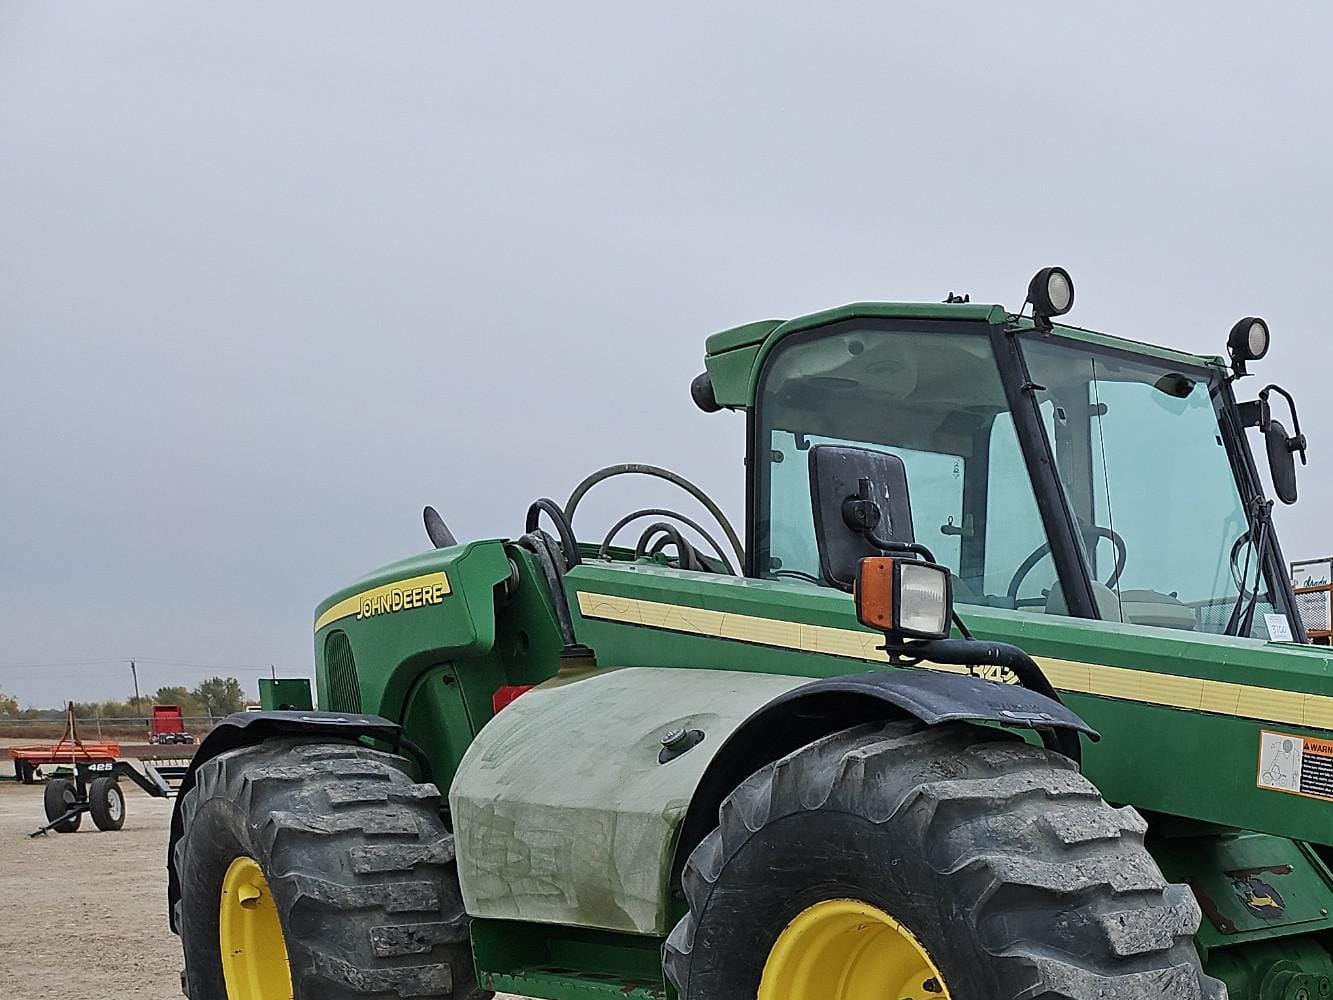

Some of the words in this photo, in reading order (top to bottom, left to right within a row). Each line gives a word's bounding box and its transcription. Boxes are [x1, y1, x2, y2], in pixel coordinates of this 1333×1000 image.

[357, 594, 391, 620] JOHN
[391, 583, 444, 612] DEERE
[88, 763, 113, 771] 425
